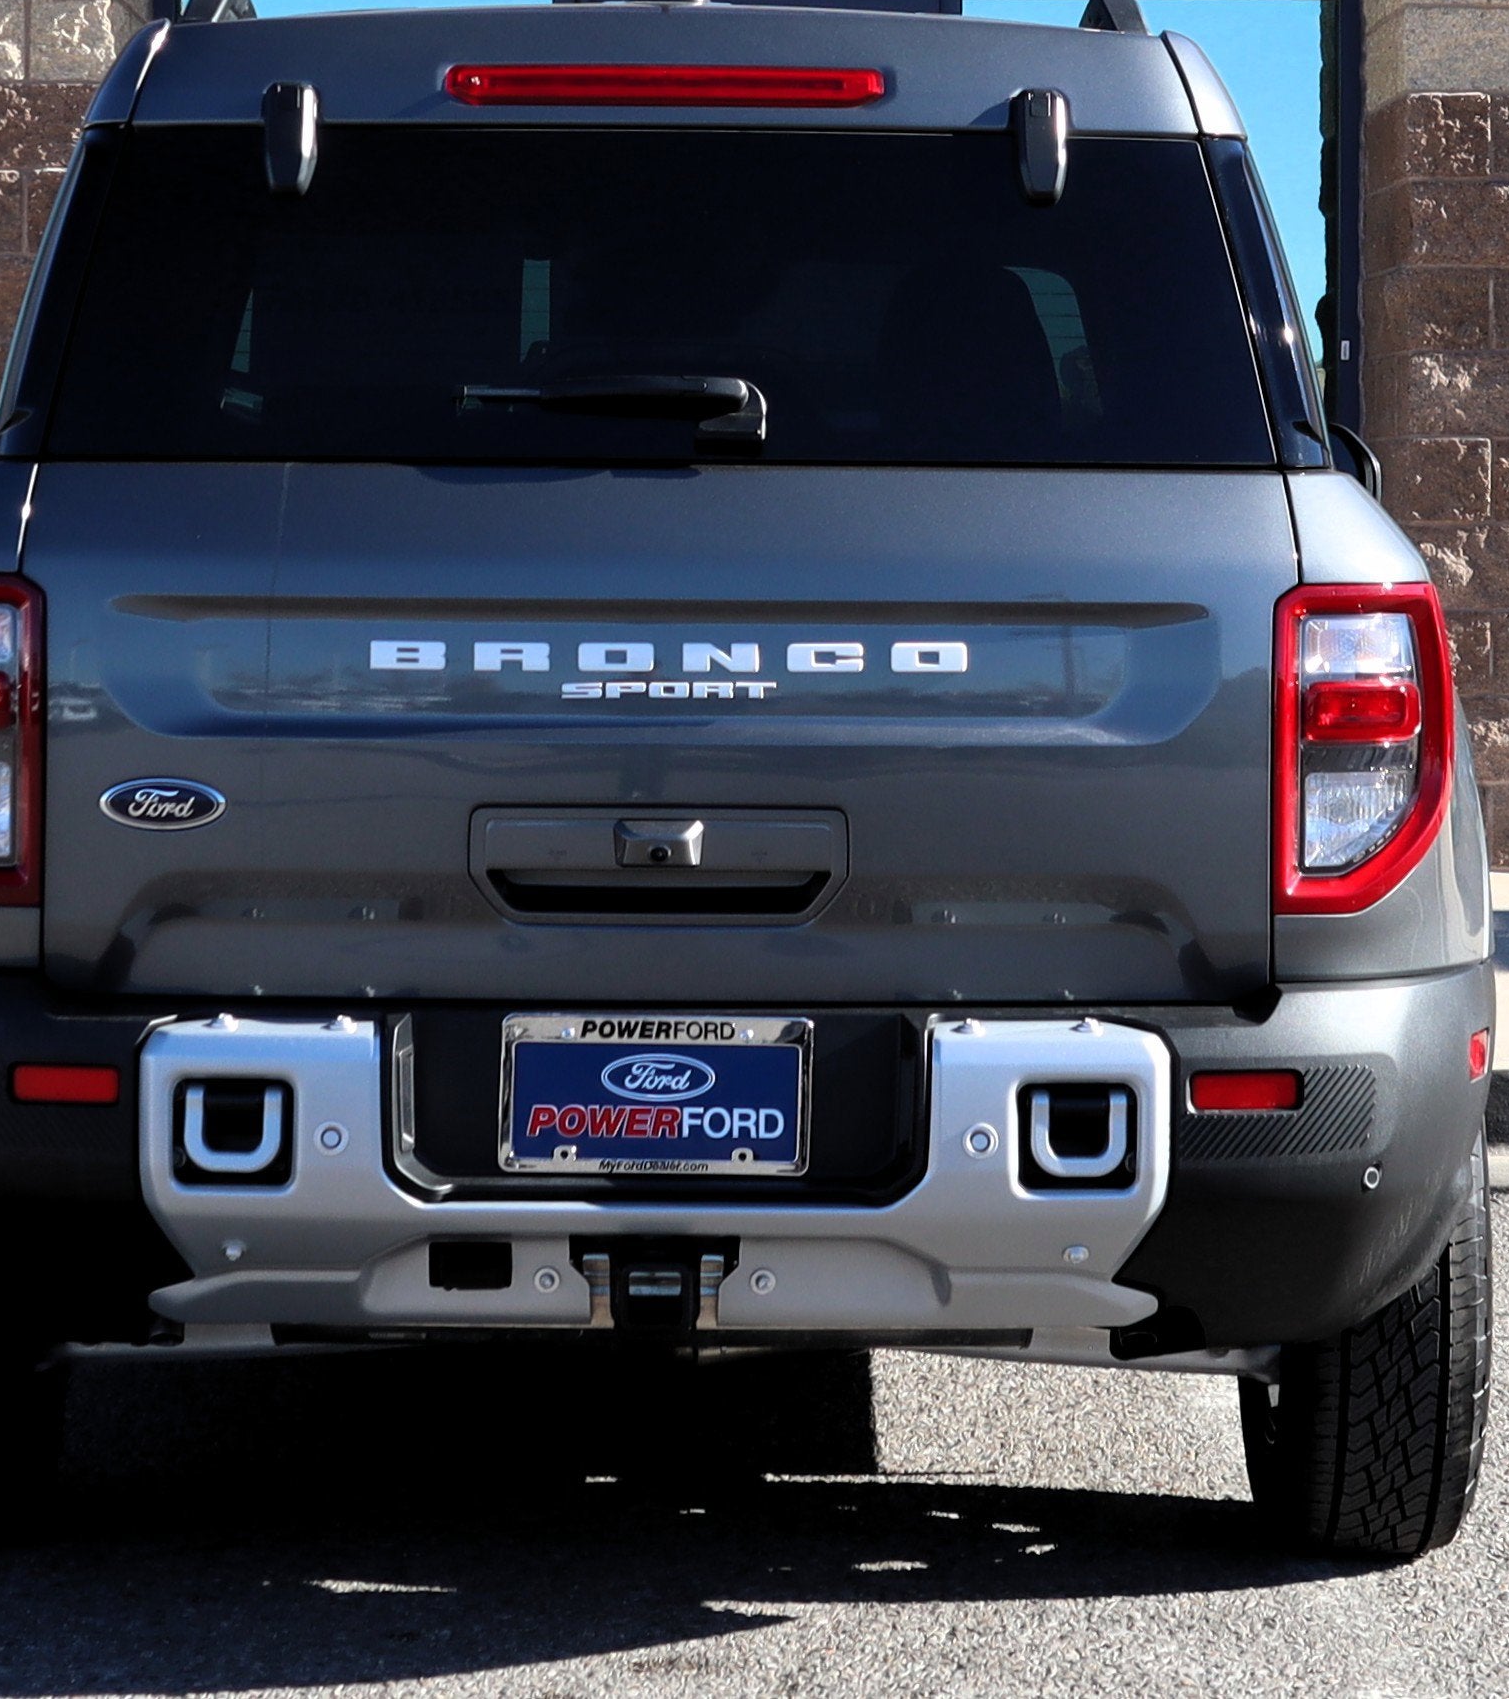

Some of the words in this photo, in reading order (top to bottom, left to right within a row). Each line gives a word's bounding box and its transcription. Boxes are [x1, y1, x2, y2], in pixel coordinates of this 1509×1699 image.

[370, 639, 969, 673] BRONCO
[560, 681, 777, 700] SPORT
[128, 789, 196, 818] Ford
[580, 1020, 736, 1041] POWERFORD
[625, 1062, 691, 1090] Ford
[527, 1105, 784, 1139] POWERFORD
